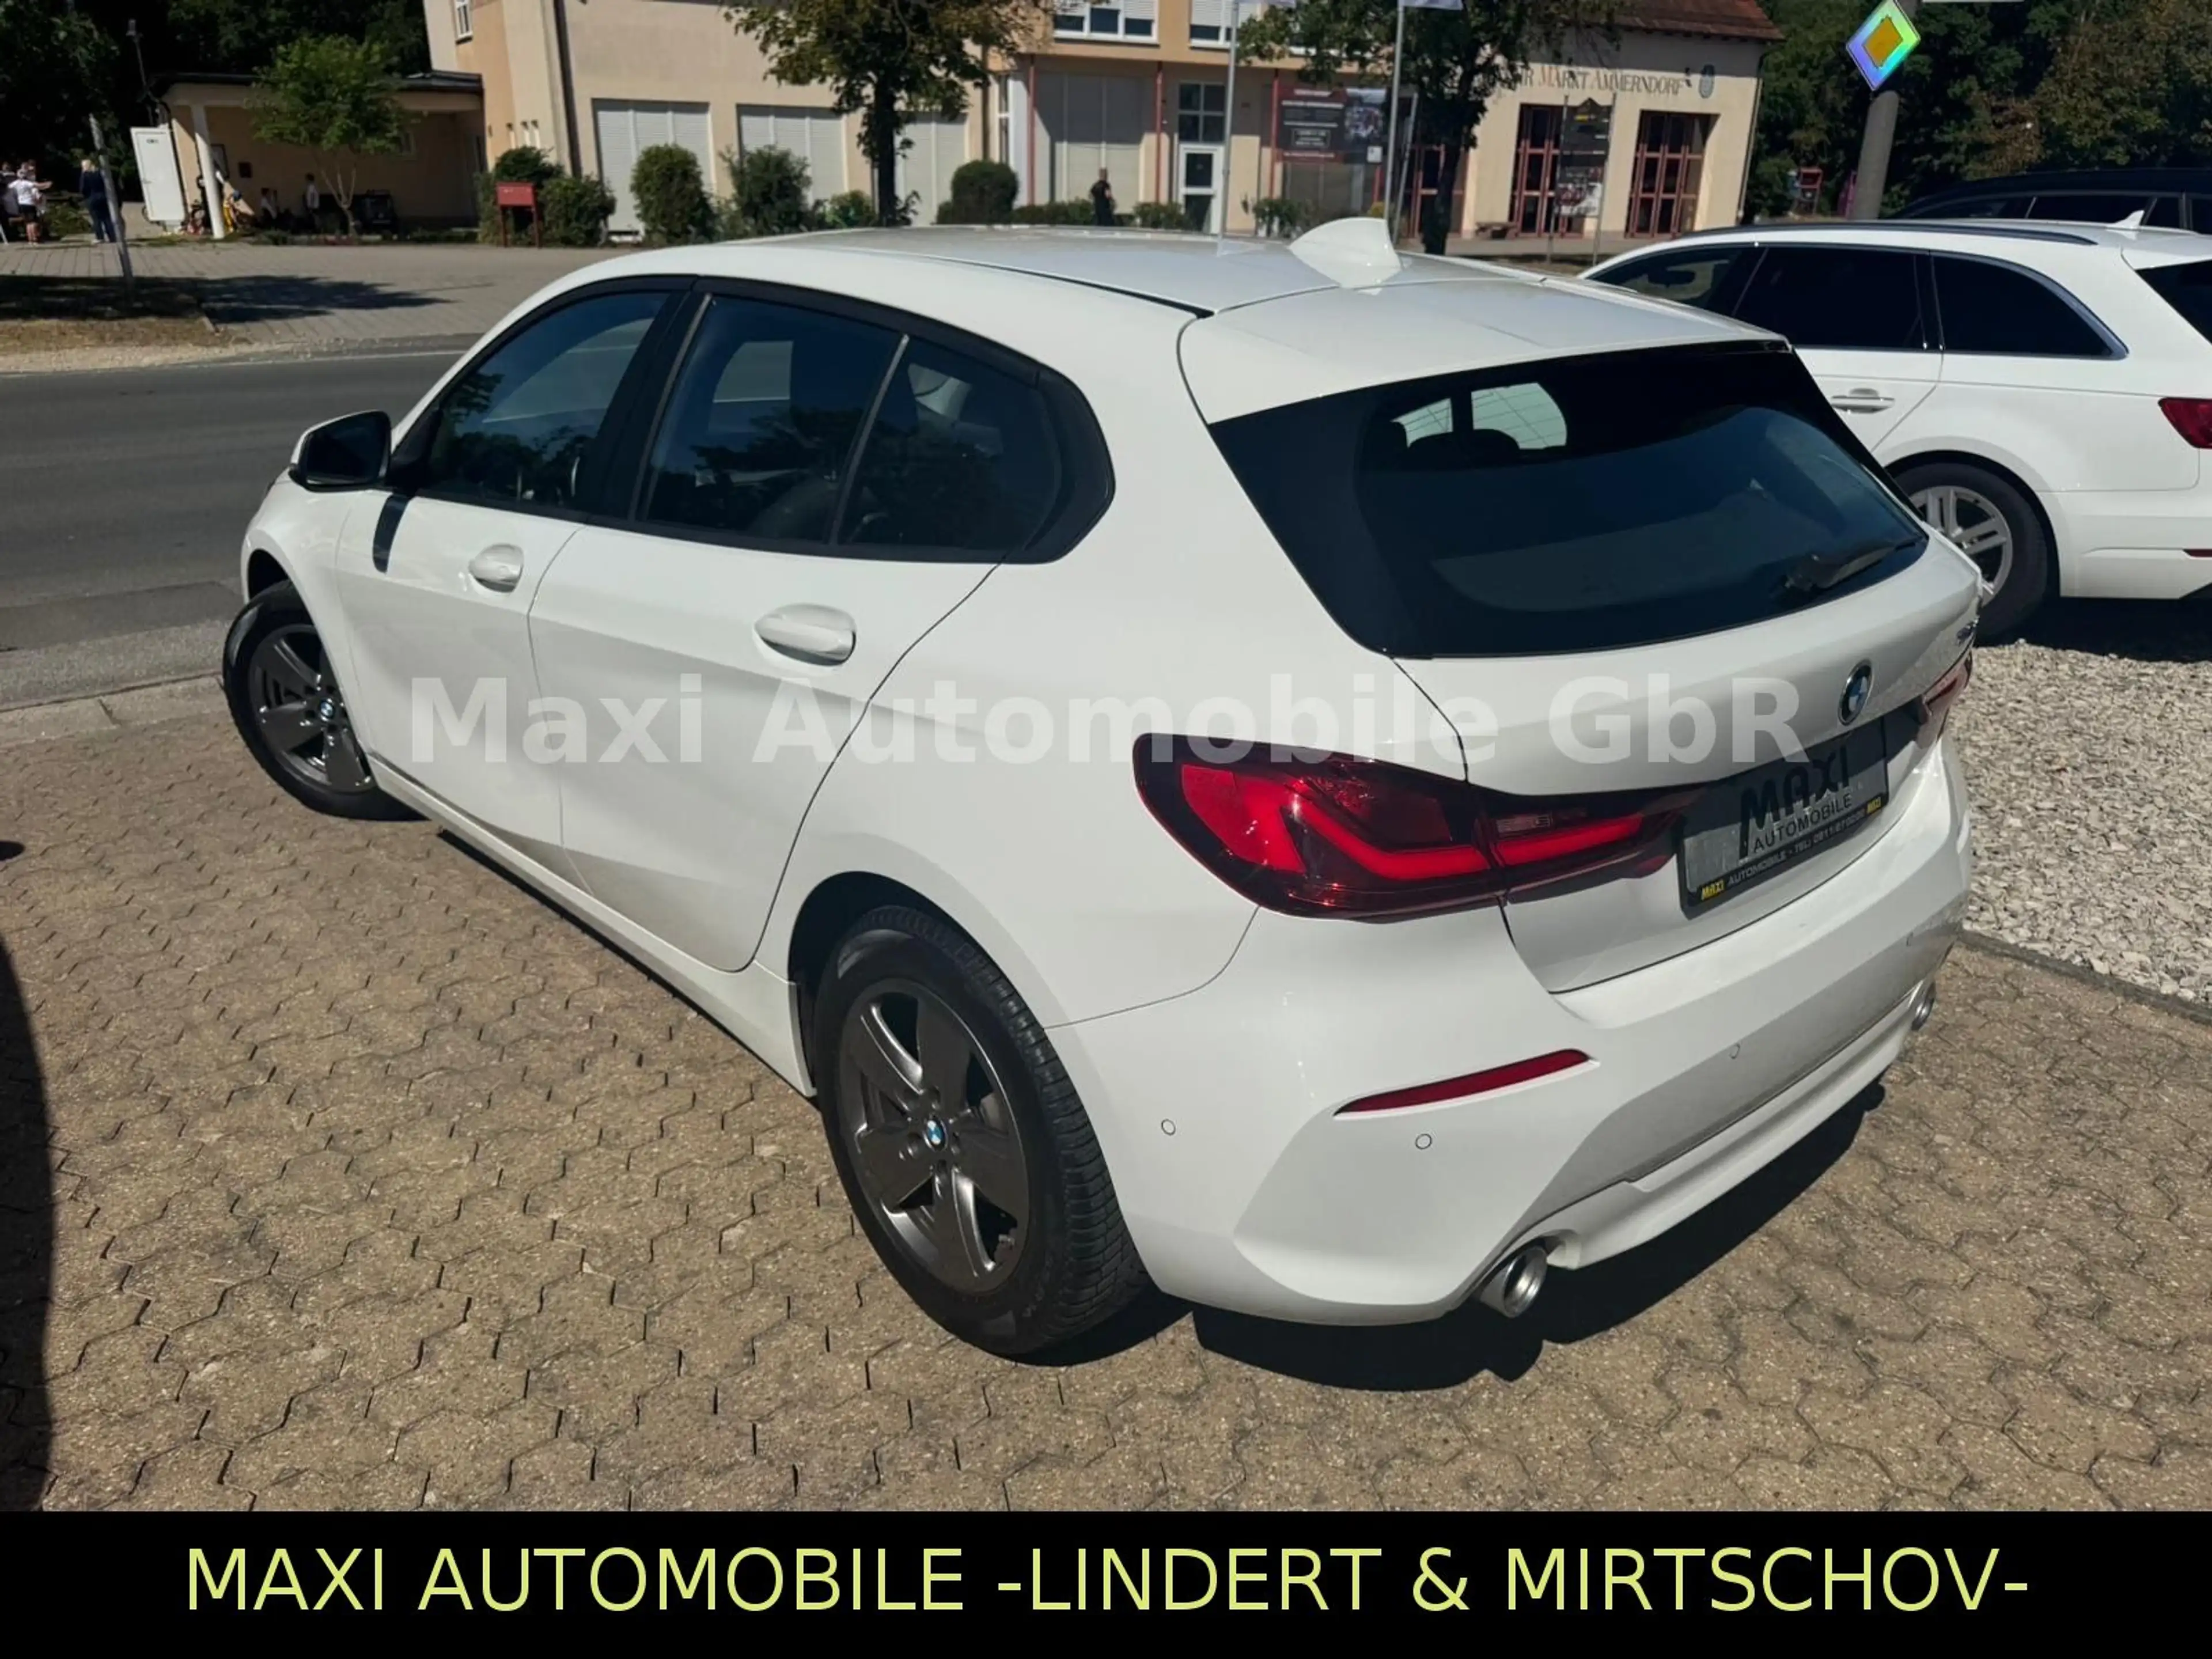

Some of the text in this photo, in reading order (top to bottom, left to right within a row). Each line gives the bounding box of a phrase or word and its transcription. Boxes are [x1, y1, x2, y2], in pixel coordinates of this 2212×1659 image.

[1538, 65, 1590, 90] MARKT
[1739, 744, 1850, 859] MAXI
[1753, 792, 1853, 853] AUTOMOBILE
[1701, 880, 1725, 901] MAXI
